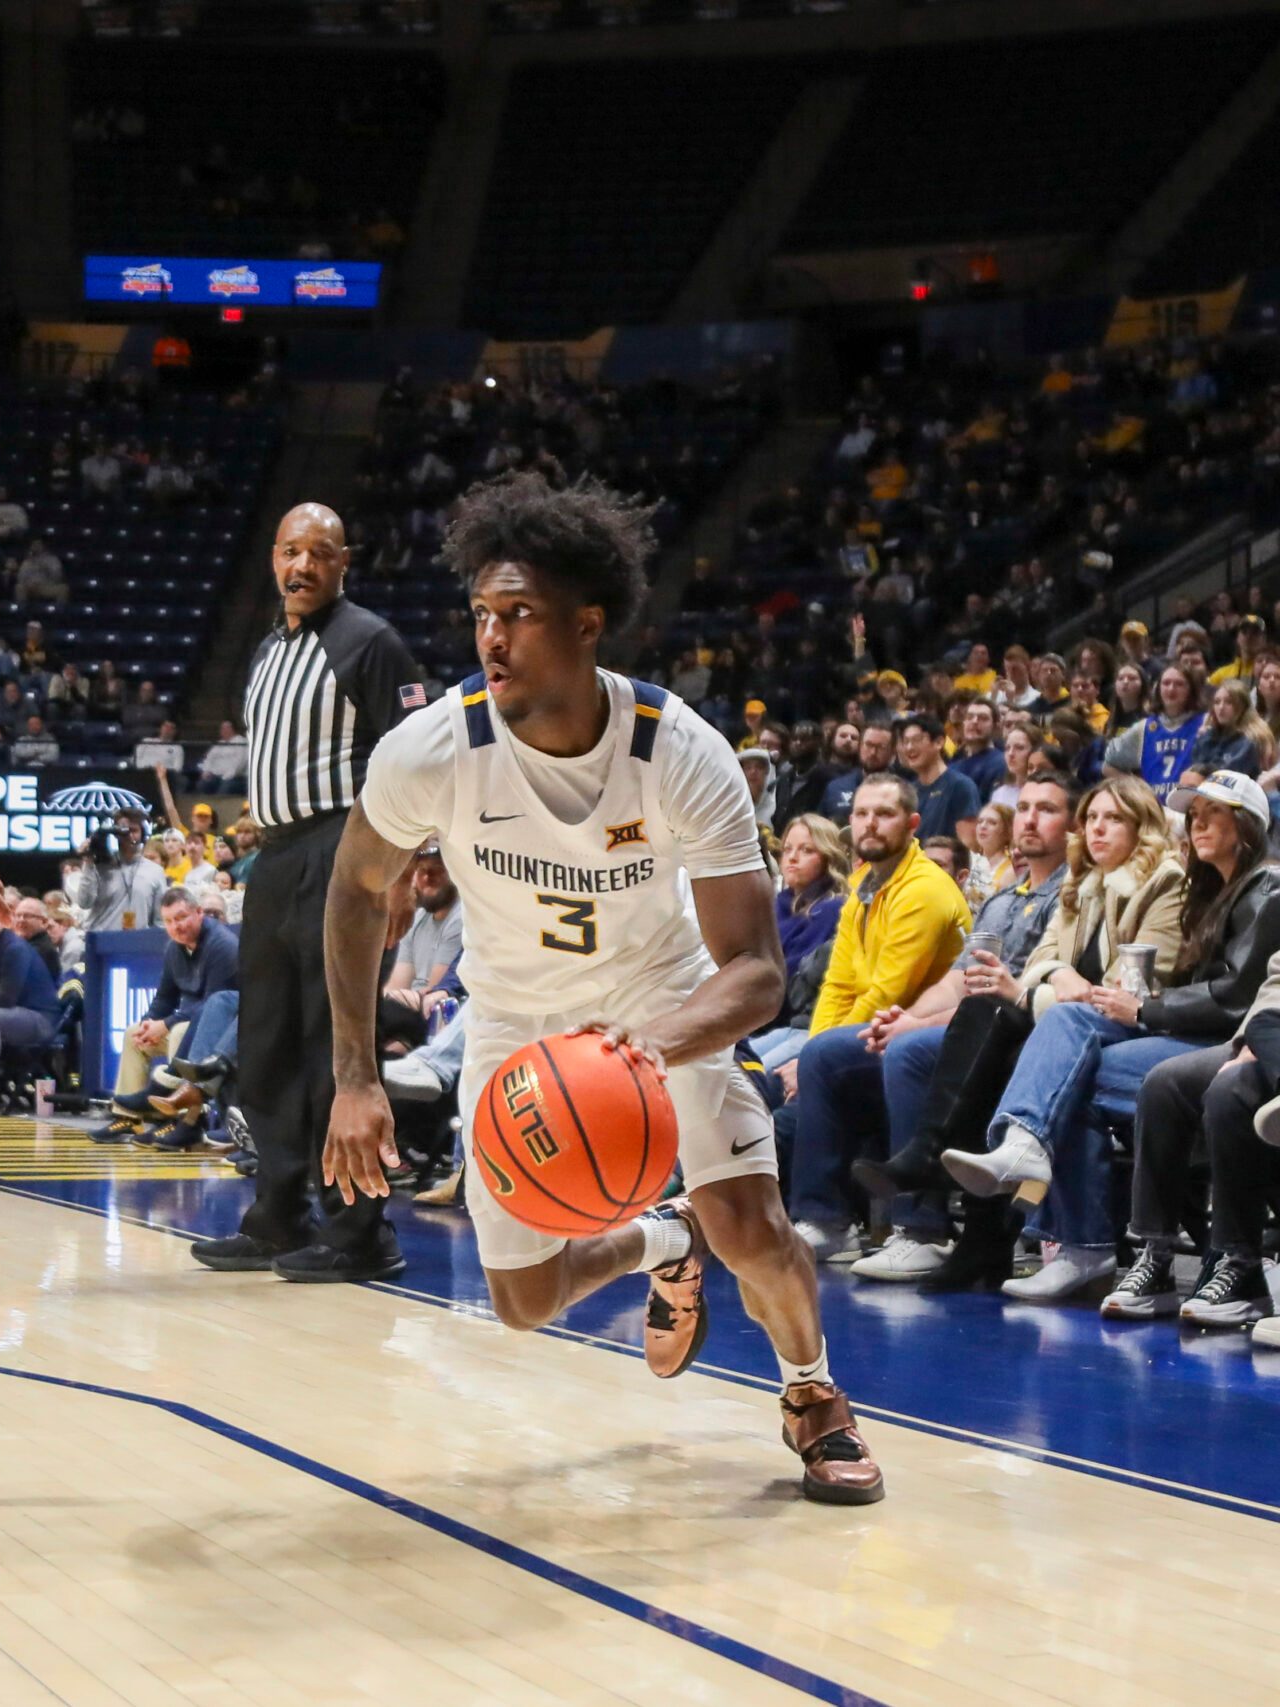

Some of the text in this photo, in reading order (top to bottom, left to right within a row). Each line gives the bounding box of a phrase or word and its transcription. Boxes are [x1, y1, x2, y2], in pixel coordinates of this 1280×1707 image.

[1163, 756, 1176, 779] 7
[473, 843, 654, 894] MOUNTAINEERS
[535, 893, 598, 956] 3
[502, 1063, 561, 1167] ELITE
